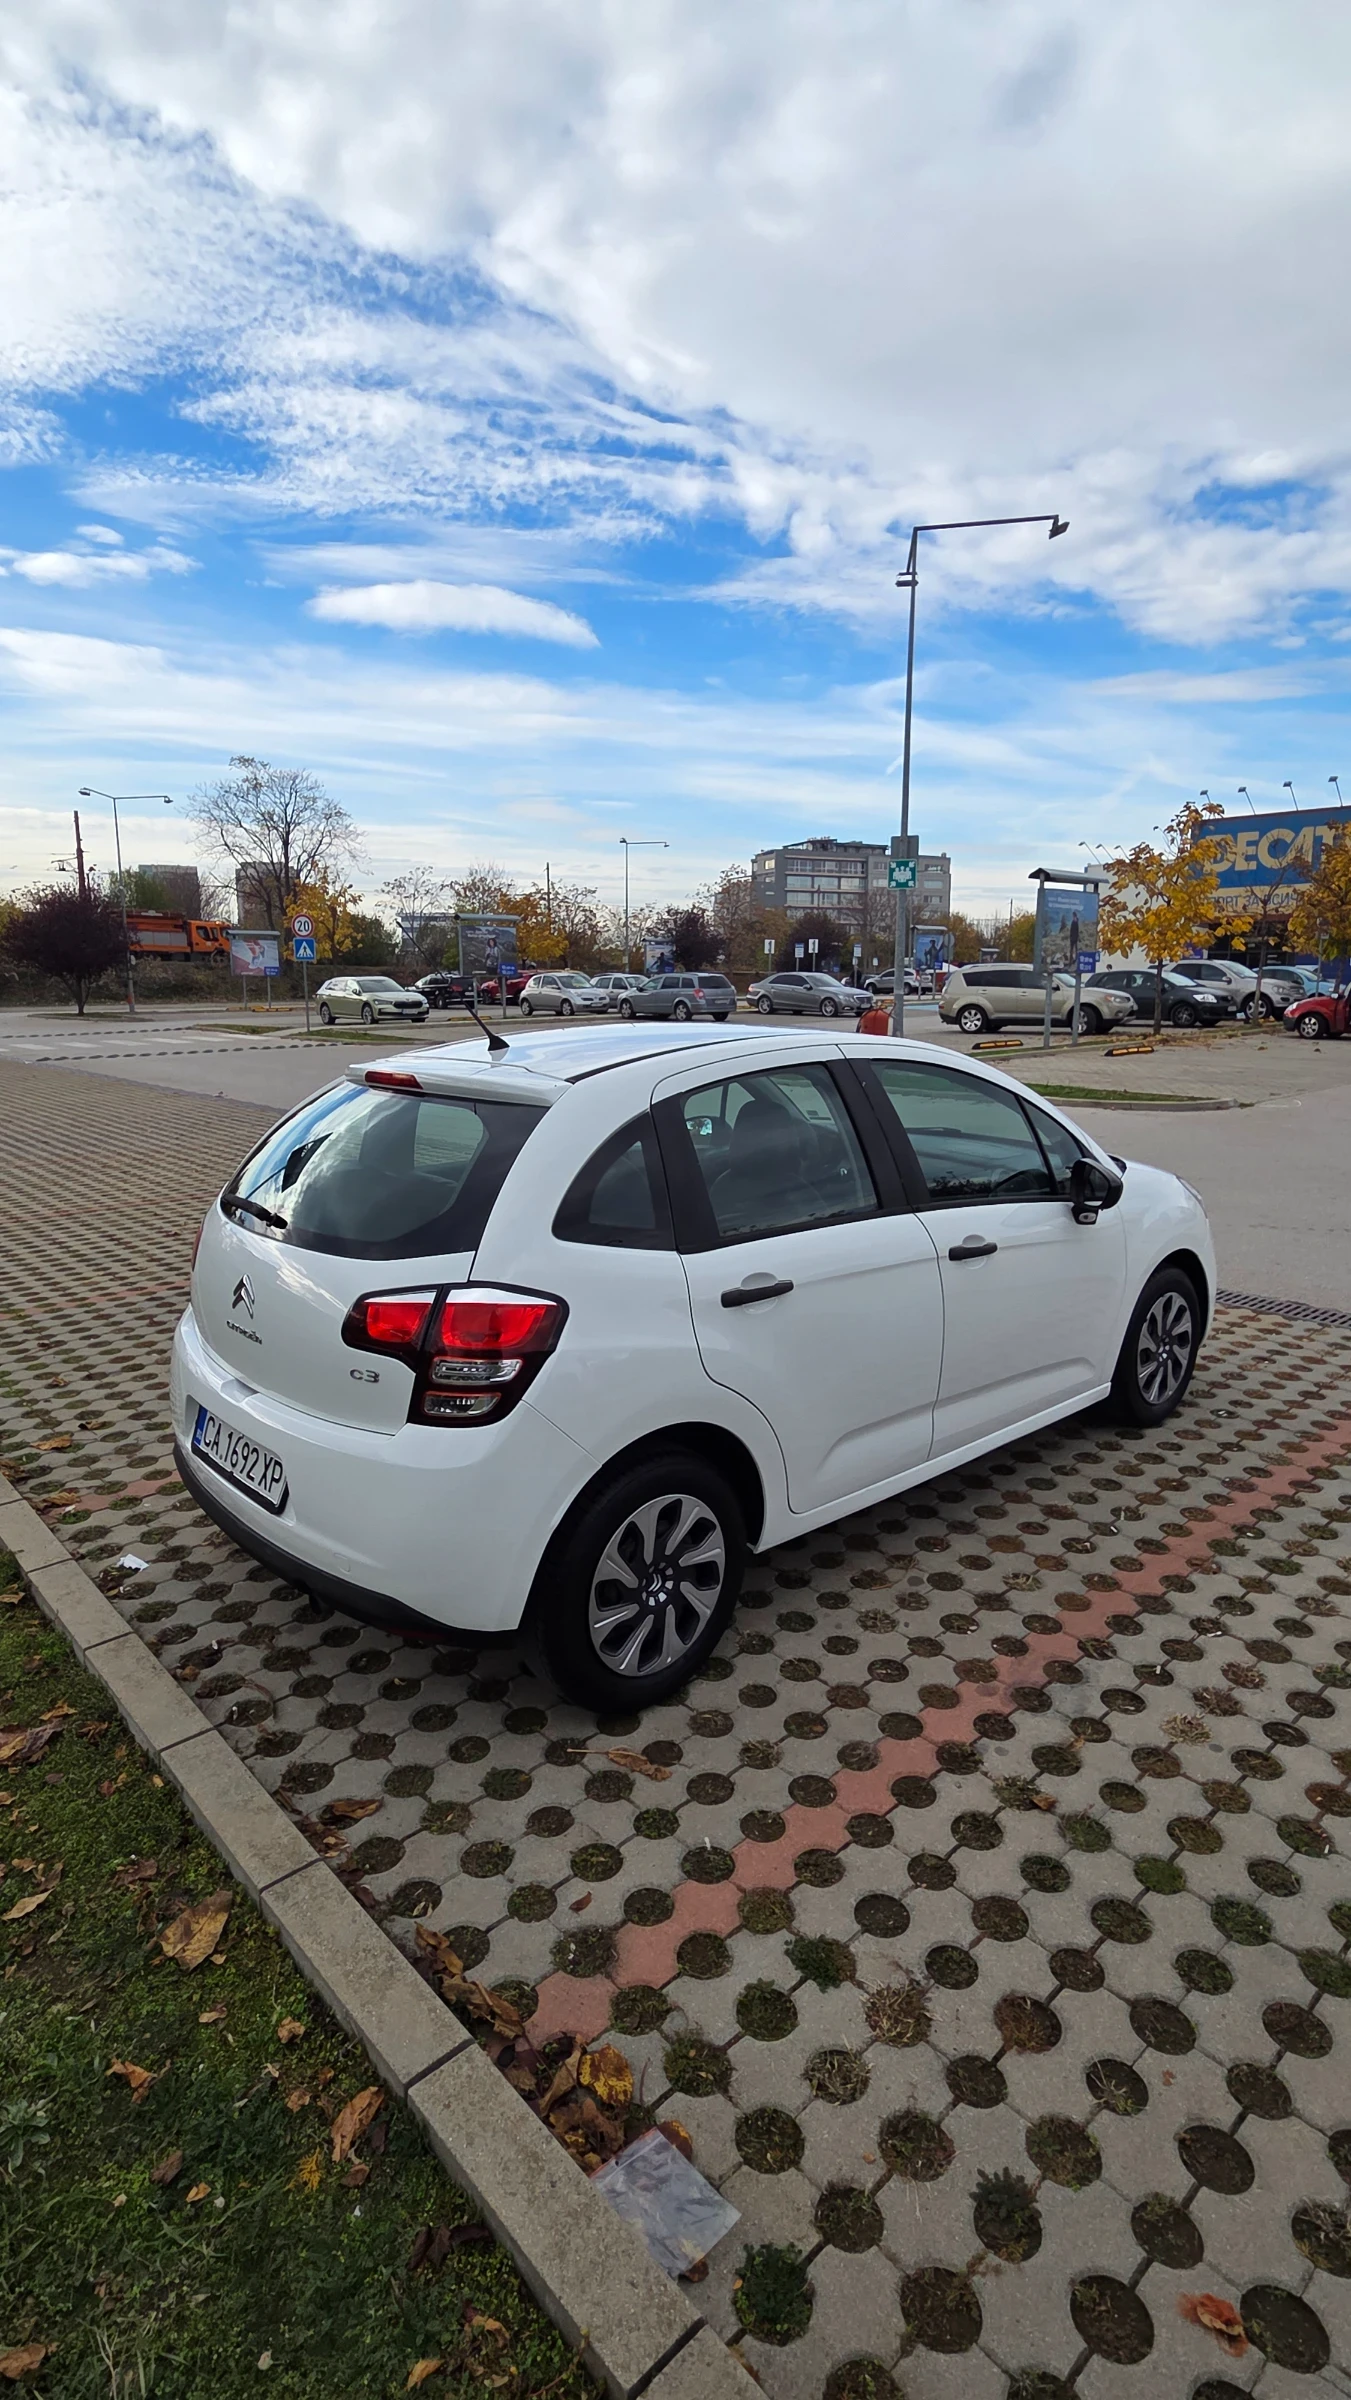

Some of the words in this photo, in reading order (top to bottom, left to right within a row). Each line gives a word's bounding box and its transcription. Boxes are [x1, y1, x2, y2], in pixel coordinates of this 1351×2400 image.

[1203, 825, 1351, 873] DECAT
[1205, 895, 1242, 908] ПОРТ
[1264, 892, 1303, 907] ВСИЧ
[297, 920, 310, 933] 20
[349, 1368, 380, 1383] C3
